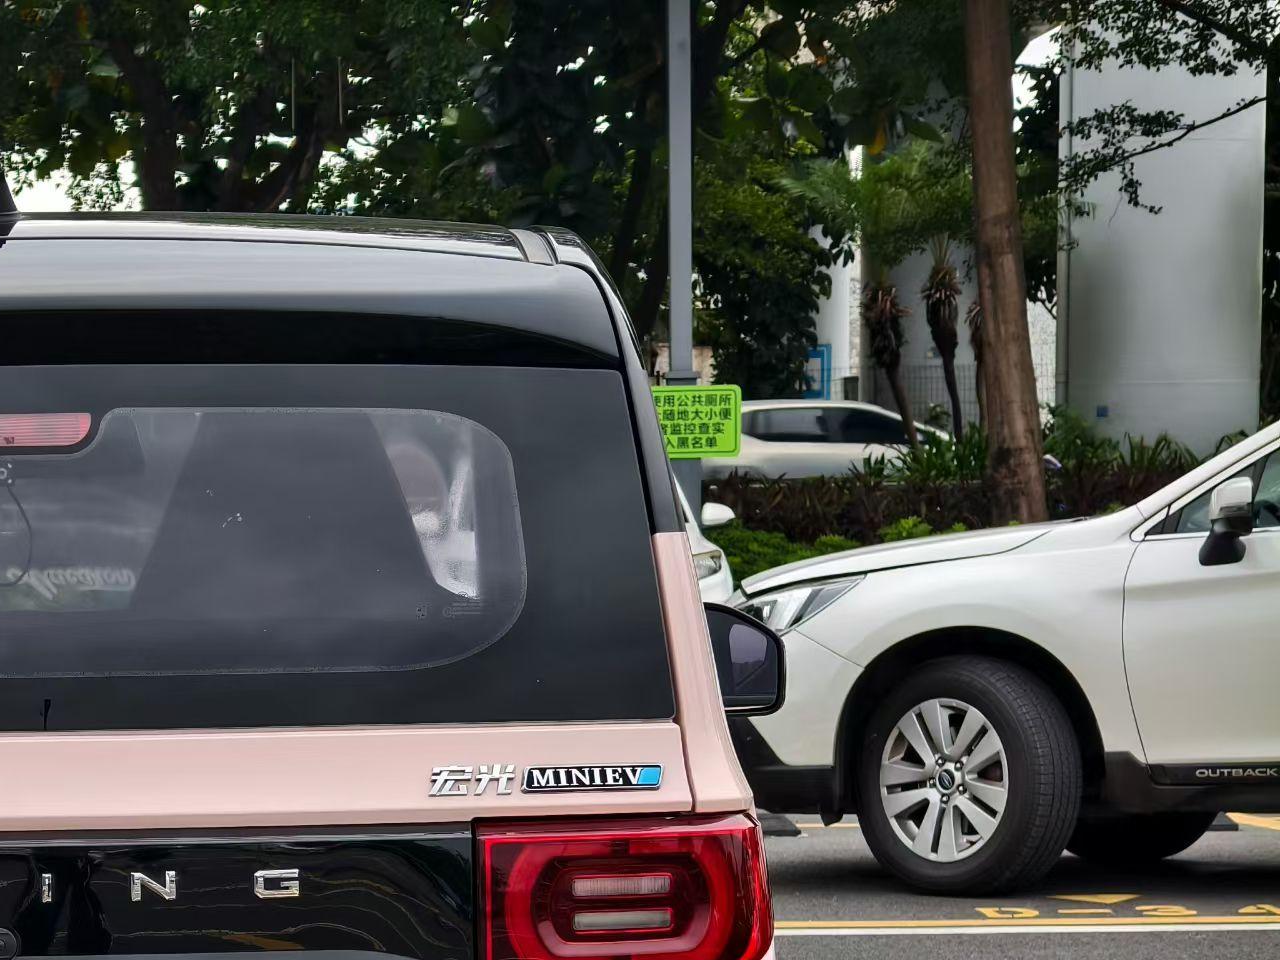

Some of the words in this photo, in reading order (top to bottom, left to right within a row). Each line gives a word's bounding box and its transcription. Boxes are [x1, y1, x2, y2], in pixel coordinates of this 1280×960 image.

[658, 408, 732, 421] 随地大小便
[1195, 767, 1278, 778] OUTBACK
[428, 763, 516, 797] 宏光
[530, 767, 644, 787] MINIEV
